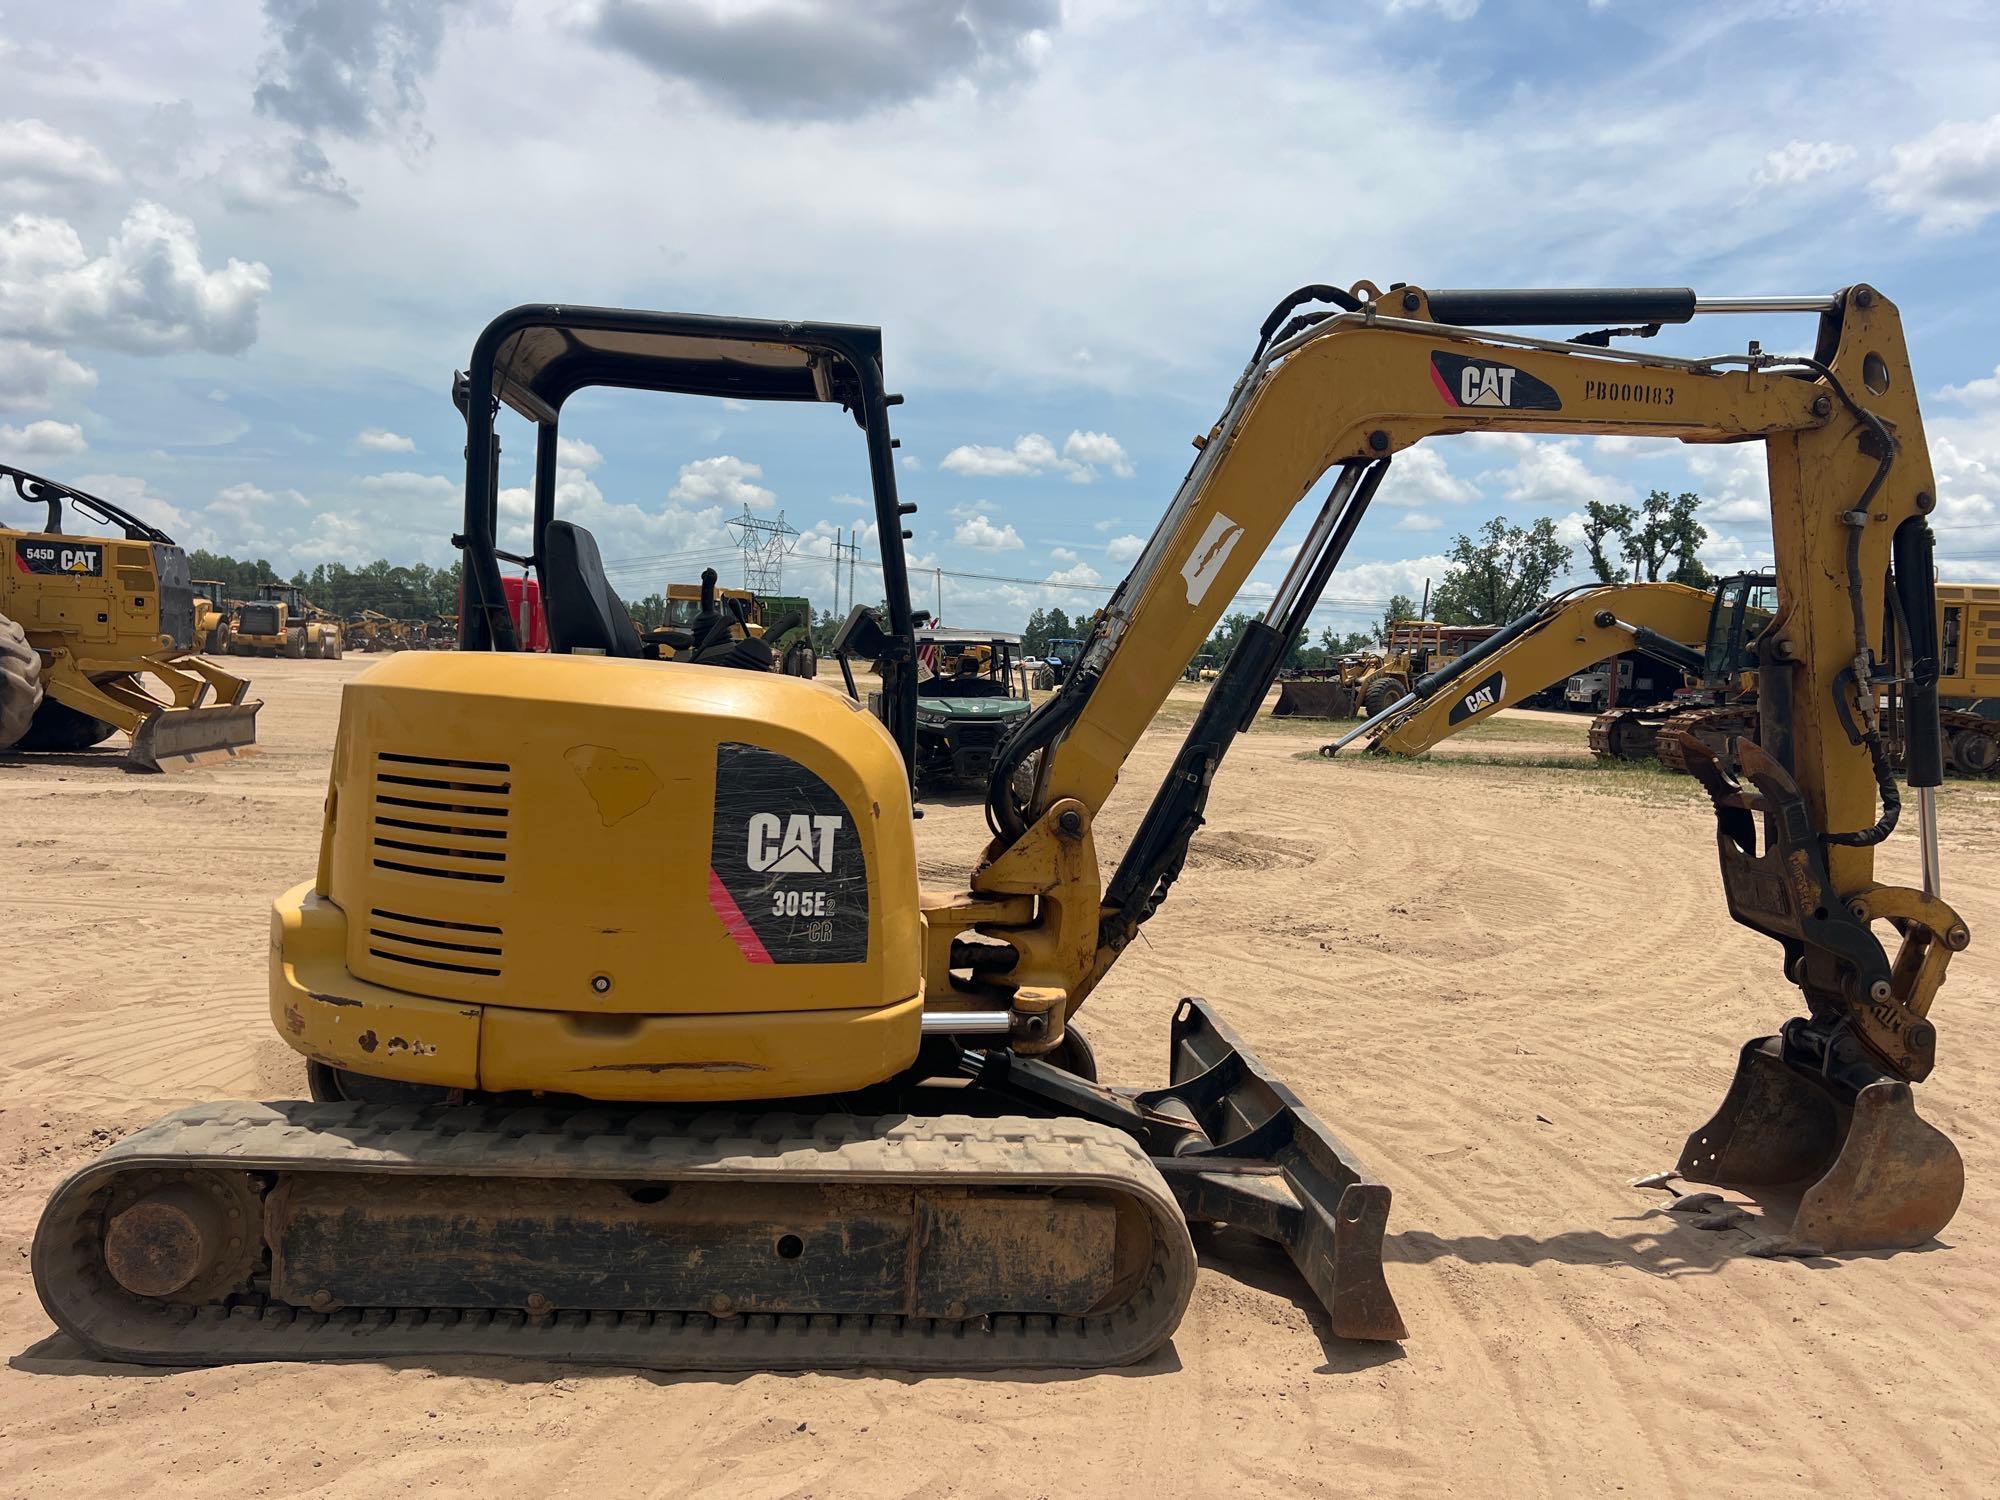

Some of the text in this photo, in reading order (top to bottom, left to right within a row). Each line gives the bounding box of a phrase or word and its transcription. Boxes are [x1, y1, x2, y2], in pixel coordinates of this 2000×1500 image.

[1461, 366, 1516, 407] CAT
[1585, 380, 1674, 405] PB000183
[26, 548, 97, 572] 545D CAT
[1465, 686, 1495, 713] CAT
[747, 812, 843, 873] CAT
[809, 921, 833, 942] CR
